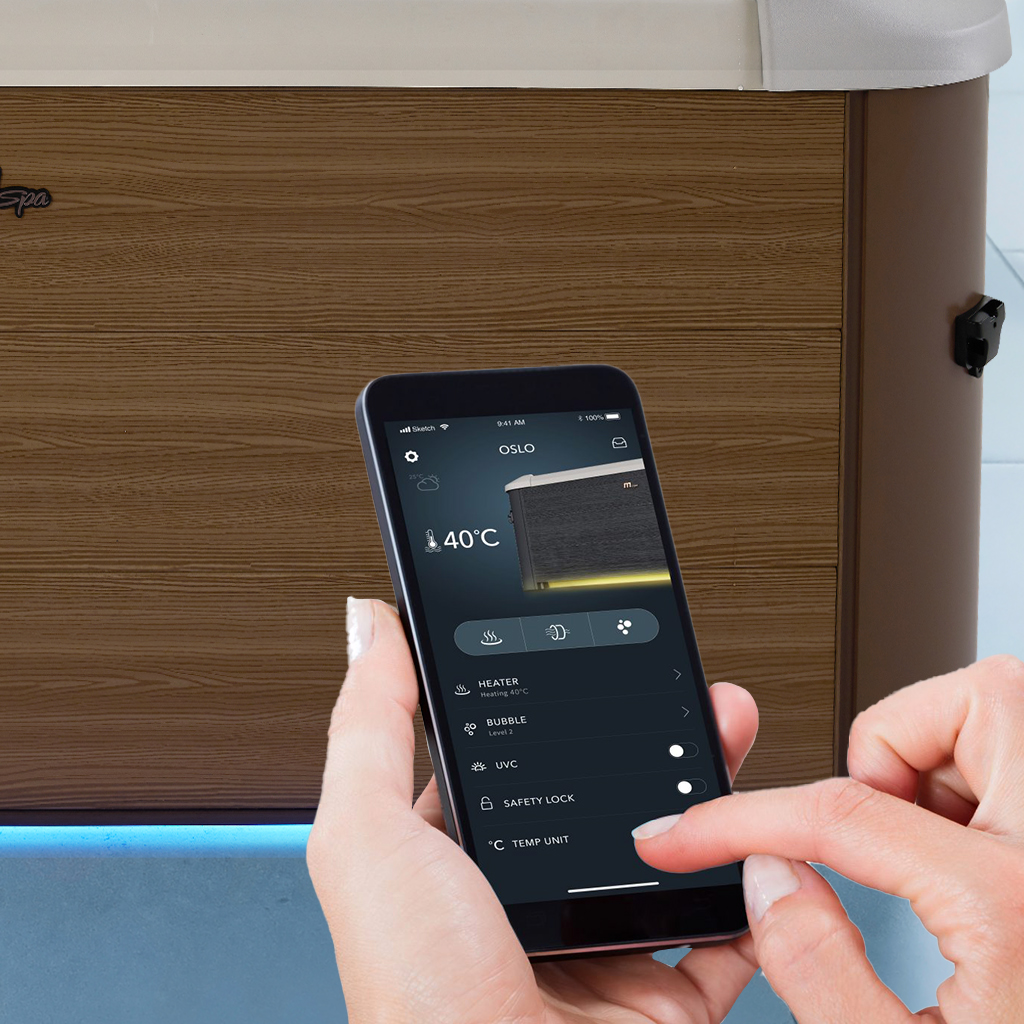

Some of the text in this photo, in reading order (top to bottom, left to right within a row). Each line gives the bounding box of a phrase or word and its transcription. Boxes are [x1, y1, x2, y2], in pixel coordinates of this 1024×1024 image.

[585, 414, 604, 422] 100%
[411, 425, 436, 433] Sketch
[496, 420, 512, 428] 9:41
[498, 443, 536, 455] OSLO
[443, 528, 500, 549] 40°C
[478, 677, 519, 688] HEATER
[480, 689, 509, 698] Heating
[486, 715, 527, 727] BUBBLE
[488, 728, 507, 737] Level
[495, 759, 518, 770] UVC
[503, 793, 575, 808] SAFETY LOCK
[512, 837, 541, 848] TEMP
[544, 835, 569, 846] UNIT
